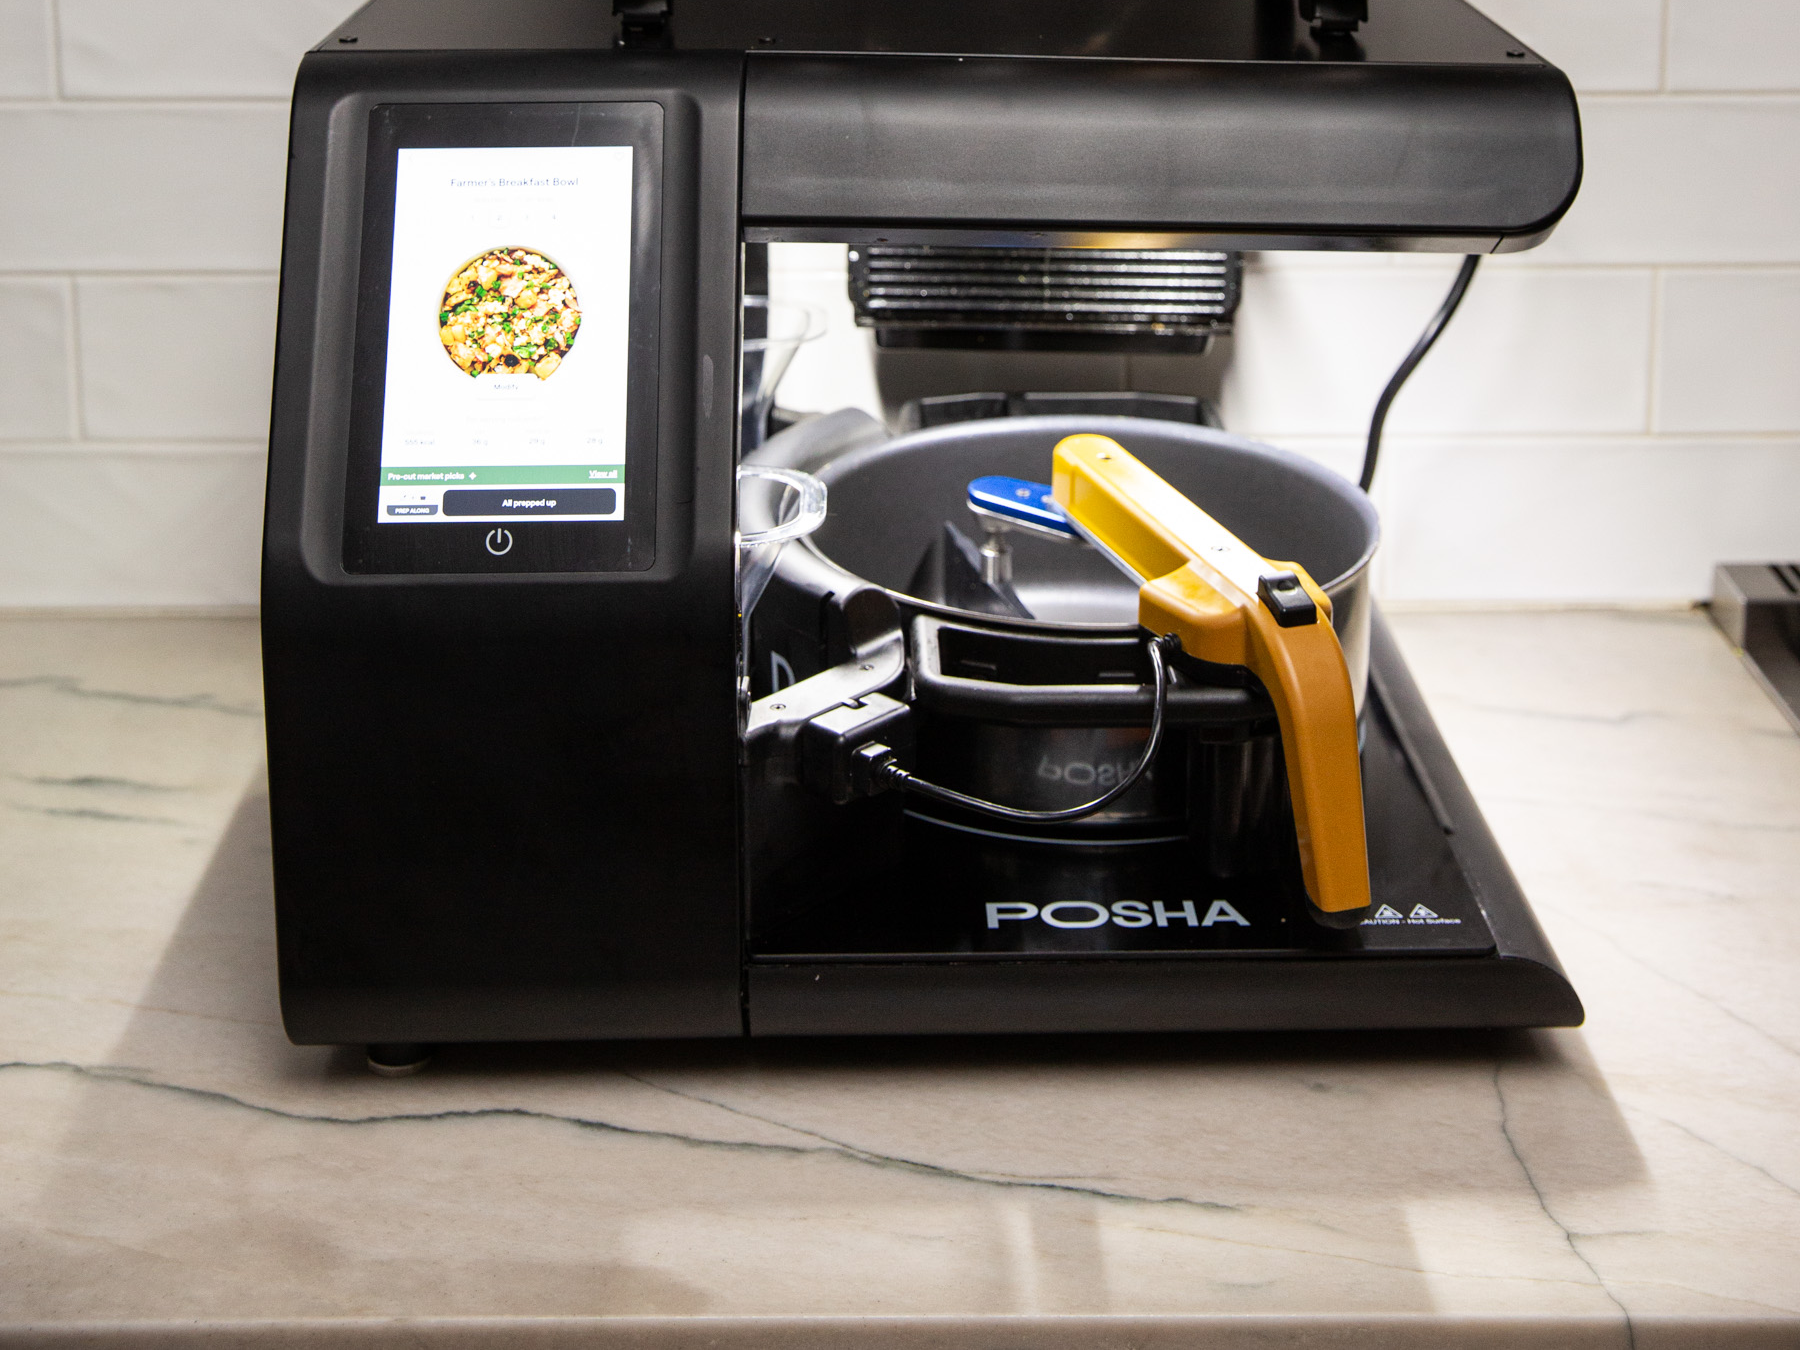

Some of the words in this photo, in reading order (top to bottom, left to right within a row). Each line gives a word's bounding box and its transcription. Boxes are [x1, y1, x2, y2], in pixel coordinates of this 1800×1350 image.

[450, 177, 497, 188] Farmer's
[498, 177, 550, 187] Breakfast
[552, 177, 579, 187] Bowl
[387, 472, 416, 481] Pre-cut
[416, 472, 444, 481] market
[444, 471, 465, 482] picks
[588, 469, 607, 479] View
[607, 469, 618, 479] all
[501, 498, 513, 508] All
[513, 498, 546, 509] prepped
[546, 499, 558, 509] up
[985, 899, 1251, 930] POSHA
[1360, 917, 1401, 926] AUTION
